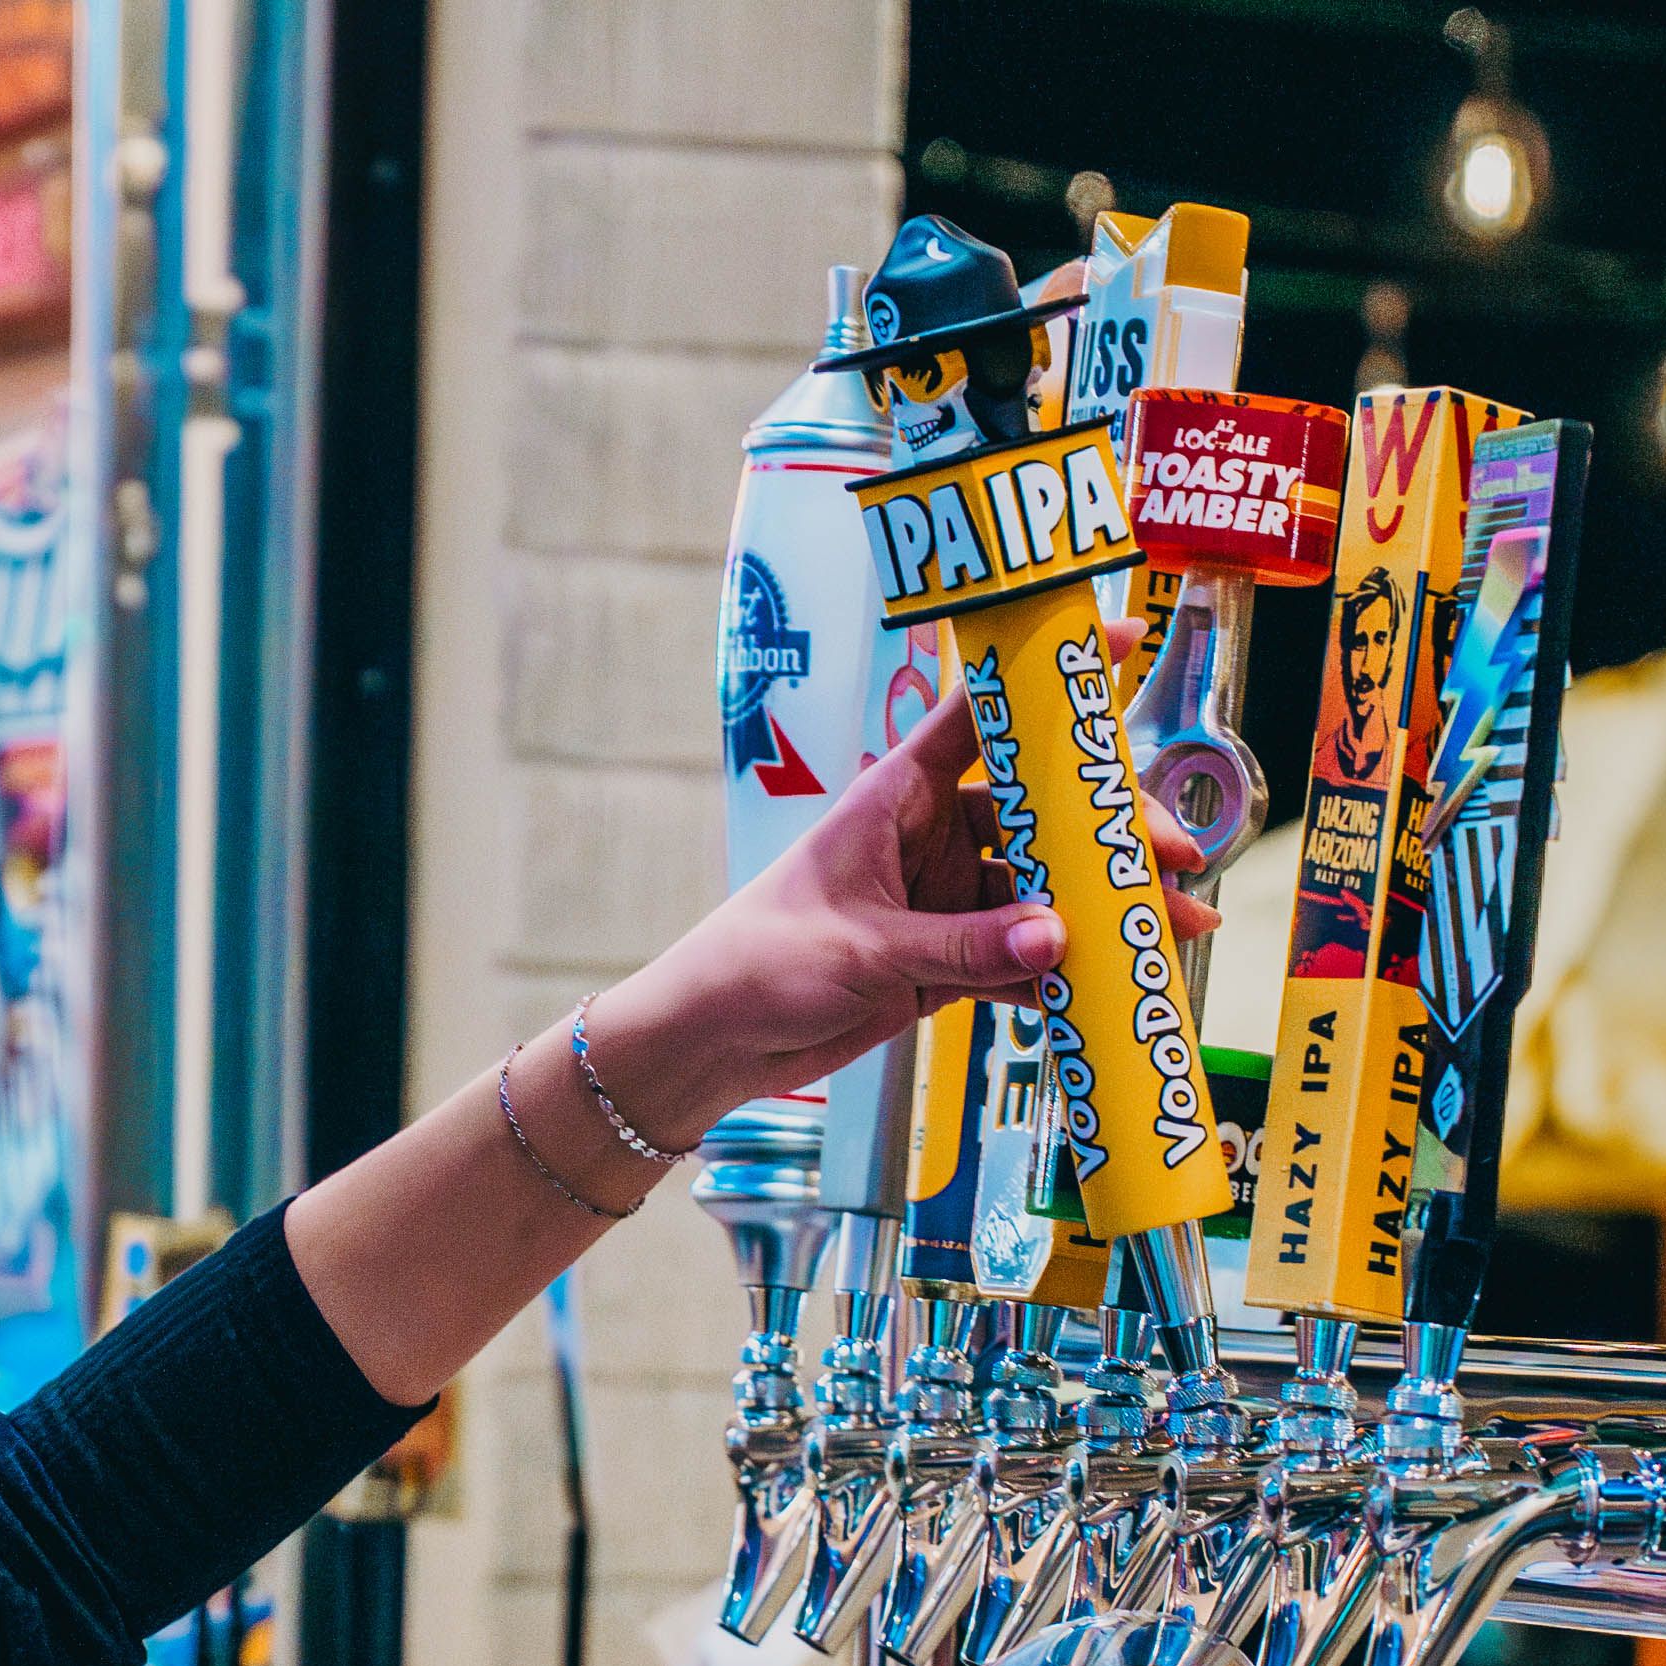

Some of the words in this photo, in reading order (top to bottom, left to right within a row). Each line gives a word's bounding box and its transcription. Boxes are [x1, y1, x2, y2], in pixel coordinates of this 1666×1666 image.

[1140, 451, 1302, 500] TOASTY
[1214, 418, 1237, 434] AZ
[861, 480, 993, 601] IPA
[983, 444, 1130, 573] IPA
[1137, 488, 1290, 538] AMBER
[964, 644, 1055, 907] RANGER
[1056, 623, 1151, 891] RANGER
[1316, 794, 1381, 837] HAZING
[1304, 826, 1378, 874] ARIZONA
[1039, 969, 1109, 1182] VOODO
[1120, 902, 1208, 1170] VOODOO
[1278, 1121, 1322, 1265] HAZY
[1300, 1009, 1338, 1093] IPA
[1366, 1128, 1412, 1277] HAZY
[1389, 1022, 1430, 1105] IPA
